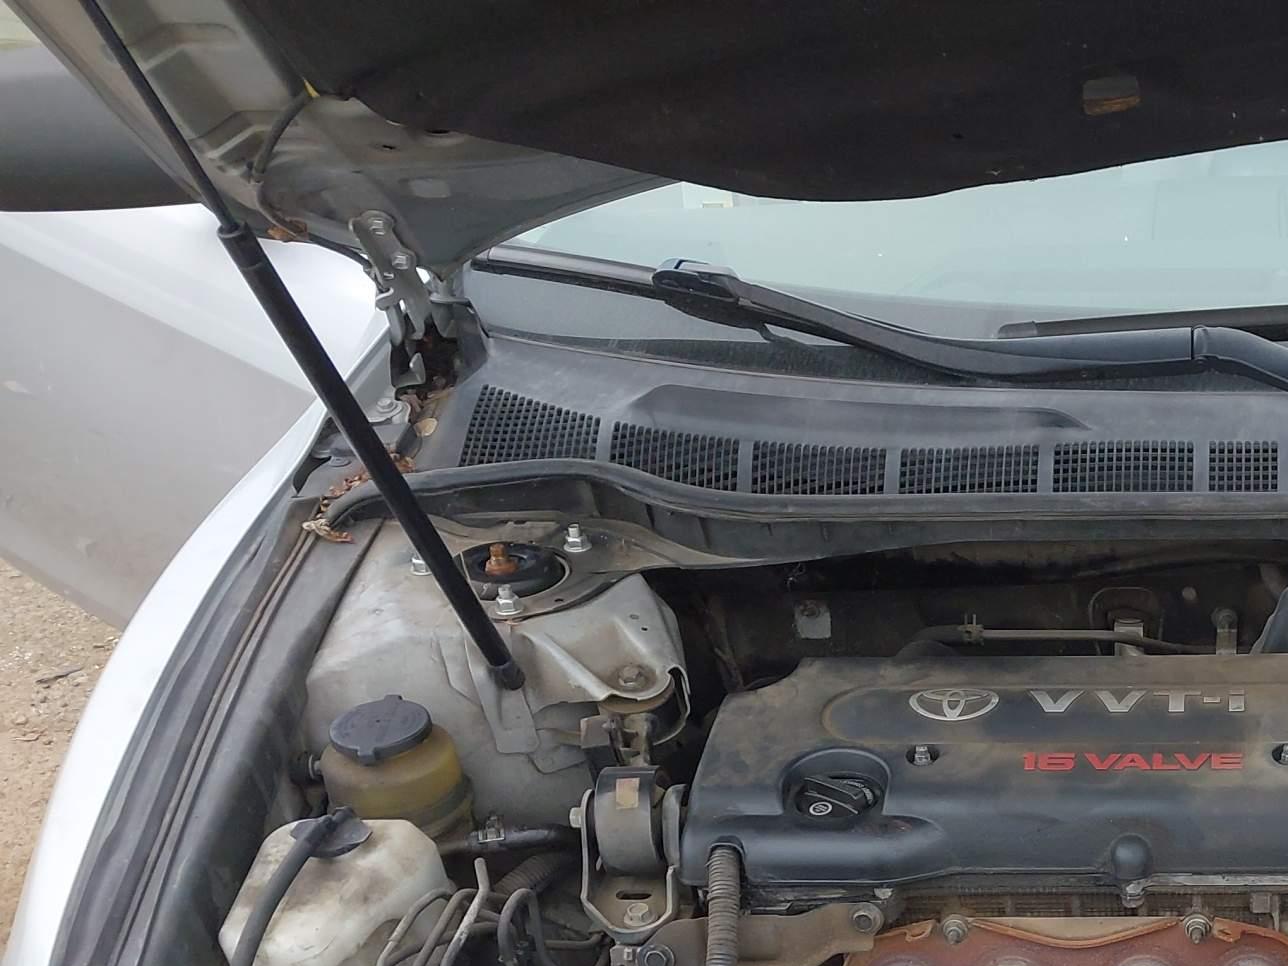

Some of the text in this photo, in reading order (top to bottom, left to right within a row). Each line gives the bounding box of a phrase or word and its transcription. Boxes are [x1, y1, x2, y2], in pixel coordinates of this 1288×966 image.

[1028, 689, 1245, 713] VVT-i
[1023, 751, 1244, 771] 16 VALVE
